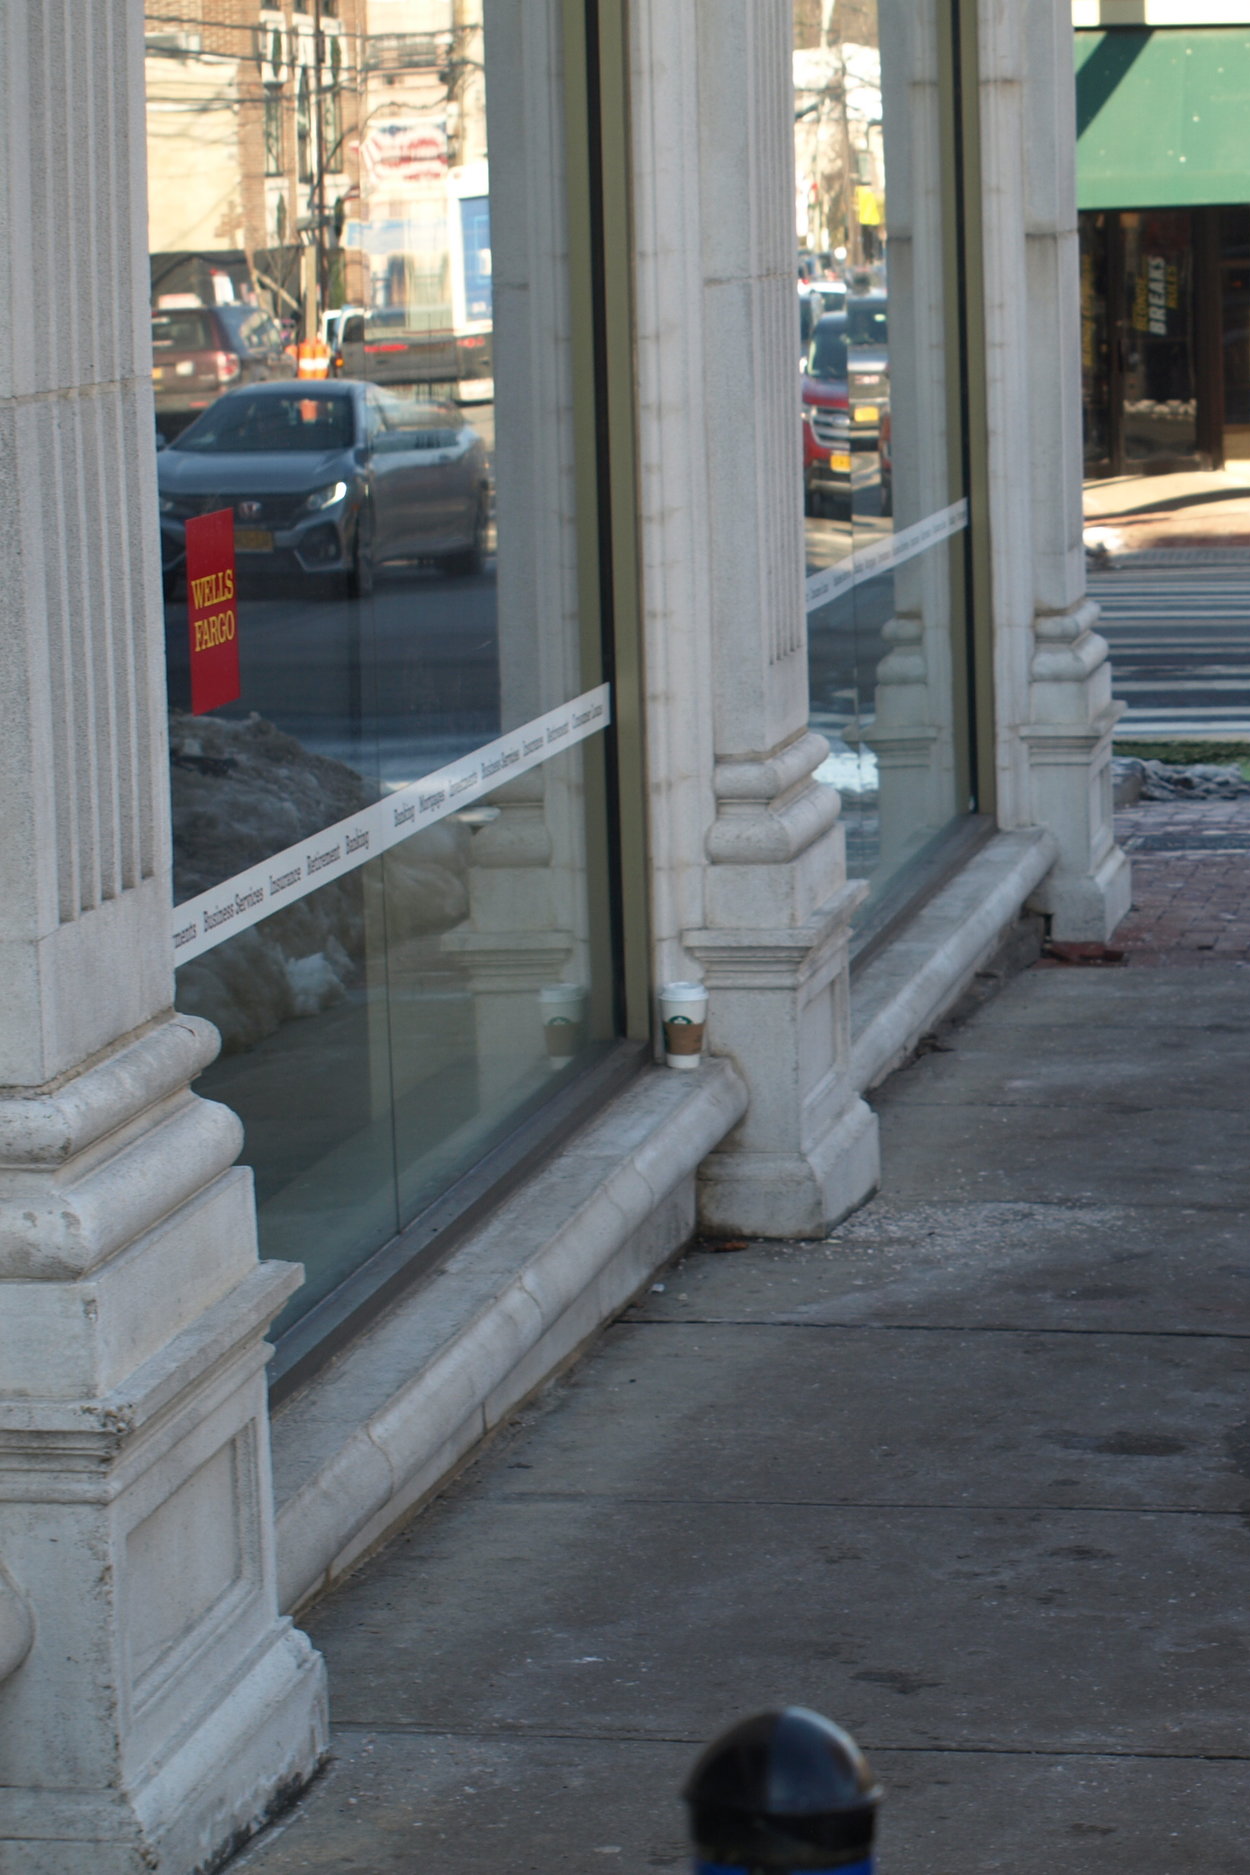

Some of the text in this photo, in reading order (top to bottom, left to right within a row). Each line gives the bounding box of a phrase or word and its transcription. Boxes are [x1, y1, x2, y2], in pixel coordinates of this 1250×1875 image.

[1148, 256, 1167, 336] BREAKS
[191, 569, 234, 610] WELLS
[194, 610, 235, 652] FARGO
[203, 904, 235, 933] Business
[235, 886, 264, 915] Services
[269, 866, 302, 896] Insurance
[306, 843, 341, 876] Retirement
[345, 827, 370, 856] Banking
